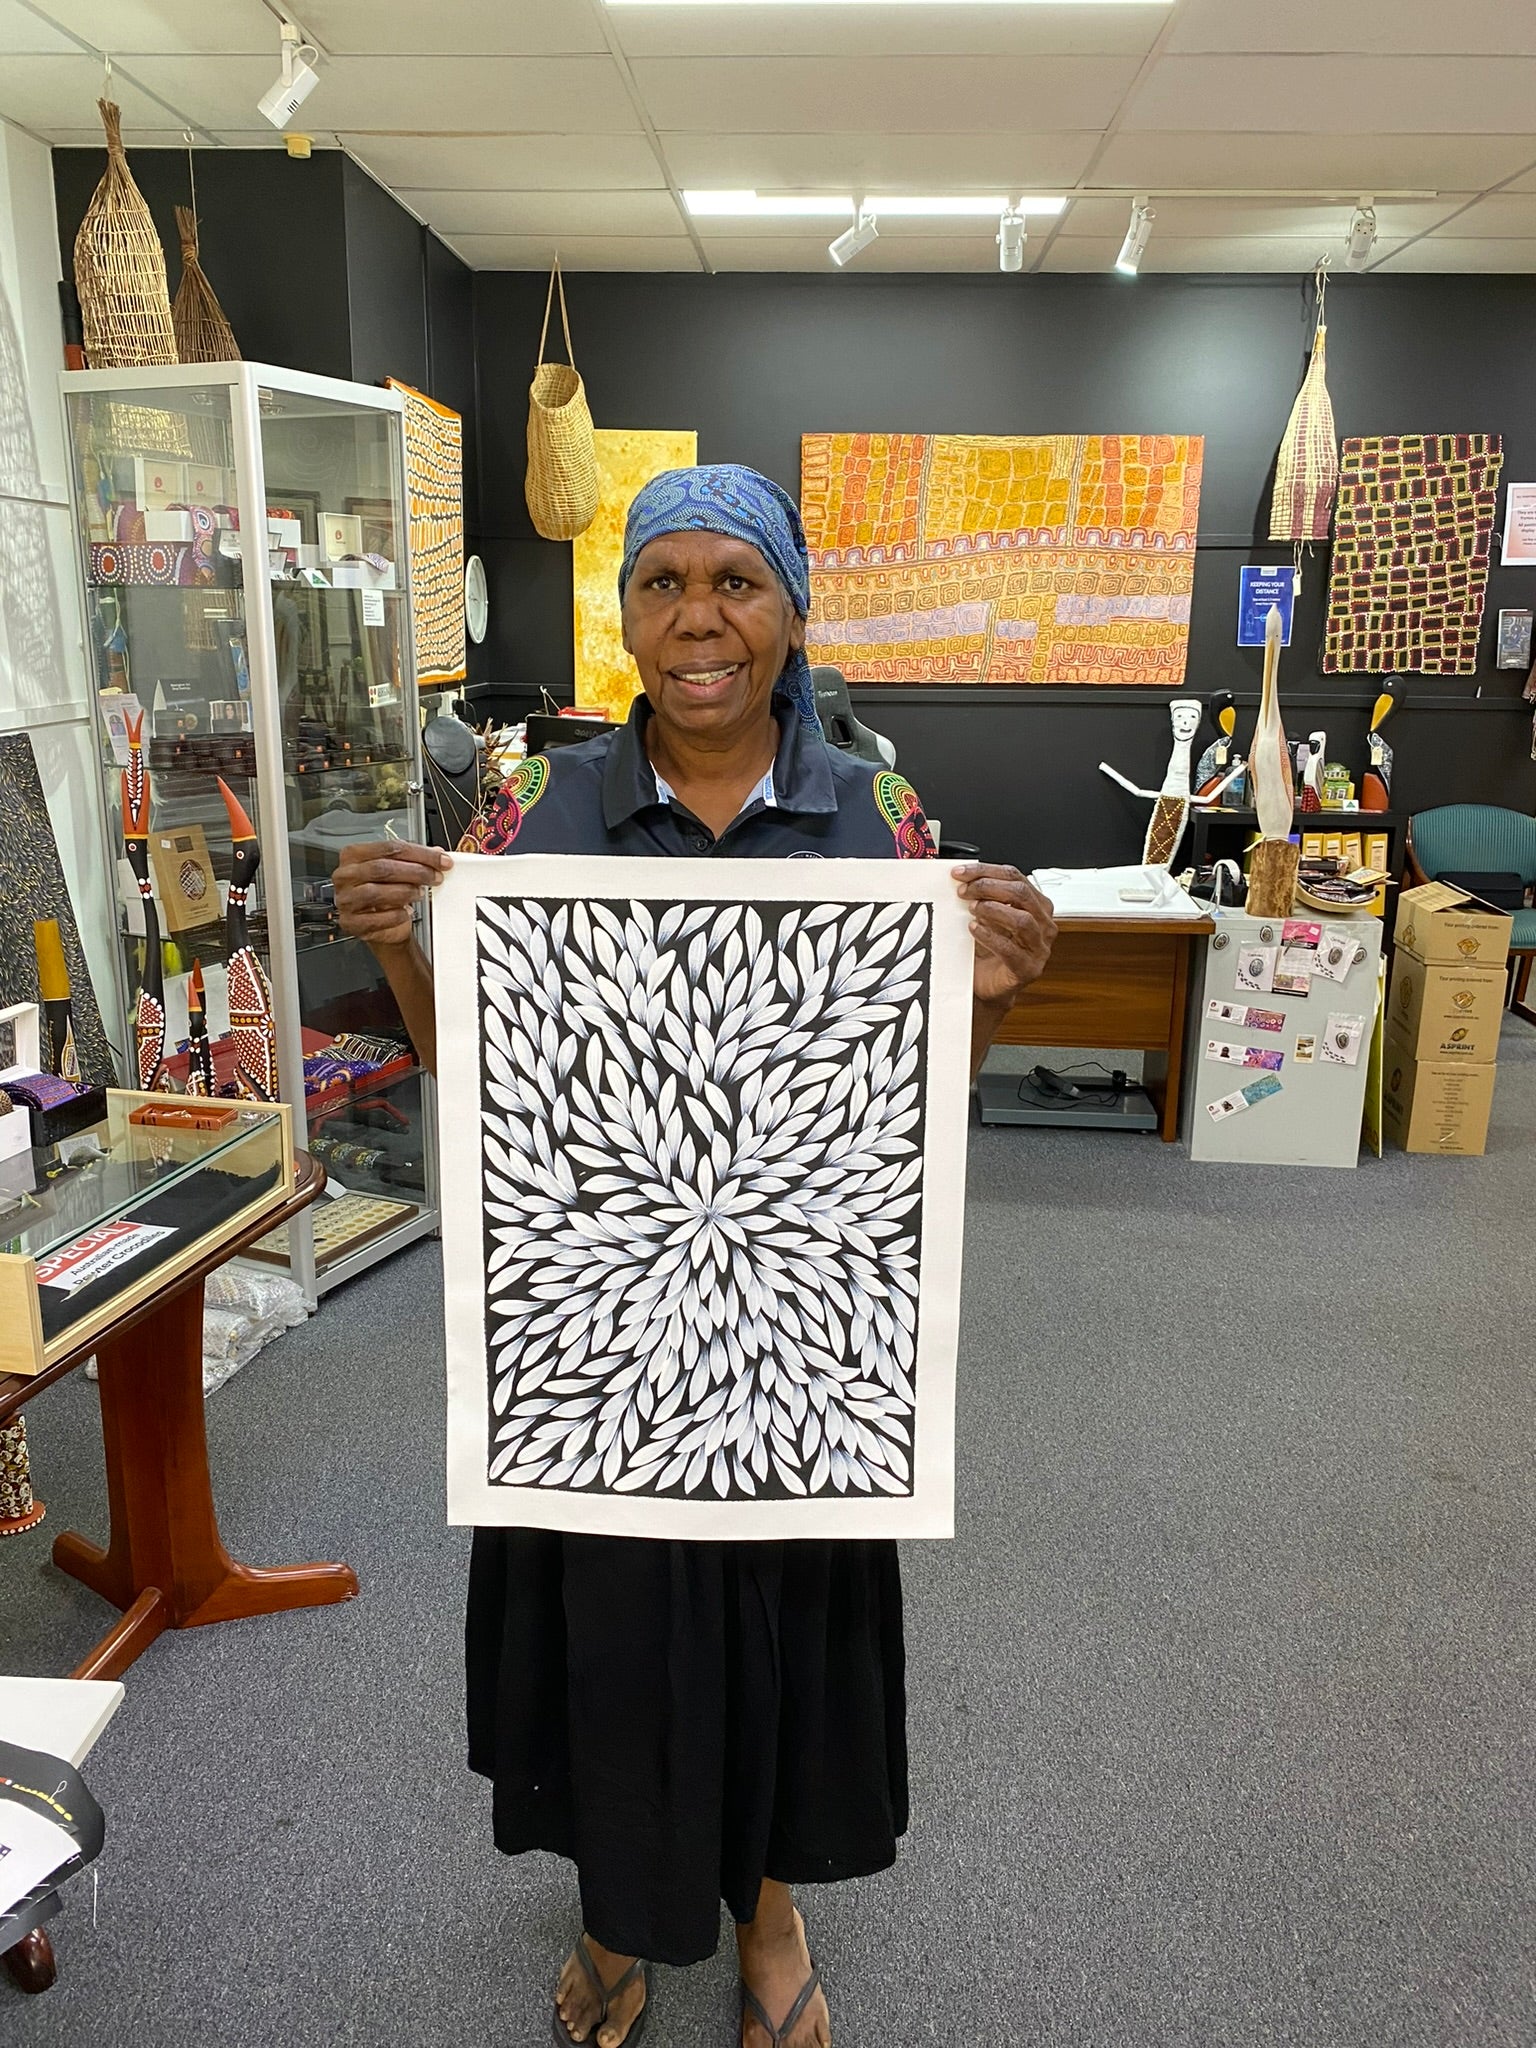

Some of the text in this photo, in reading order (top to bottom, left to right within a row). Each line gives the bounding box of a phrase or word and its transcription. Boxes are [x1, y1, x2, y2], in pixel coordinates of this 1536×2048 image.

[1439, 1042, 1476, 1051] ASPRINT
[34, 1226, 131, 1280] SPECIAL
[70, 1232, 141, 1276] Australian-made
